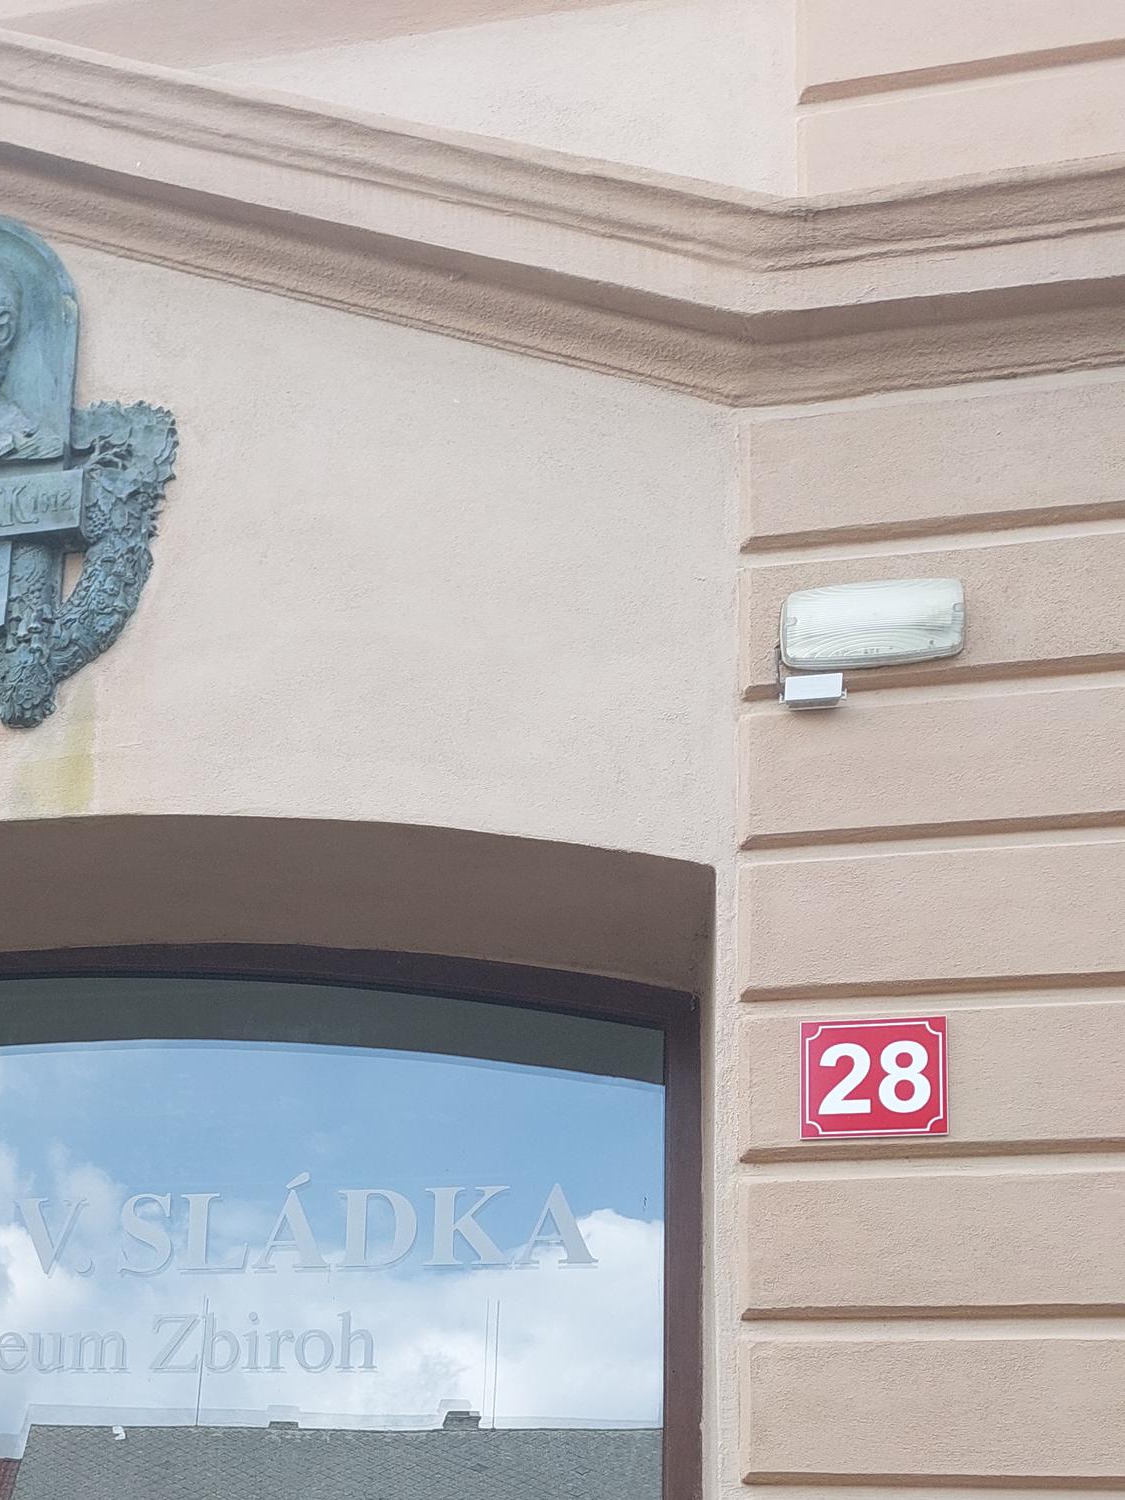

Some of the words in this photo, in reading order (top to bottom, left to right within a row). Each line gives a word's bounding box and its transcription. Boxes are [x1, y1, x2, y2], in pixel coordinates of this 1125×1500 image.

[818, 1040, 932, 1115] 28
[18, 1197, 94, 1279] V.
[116, 1171, 599, 1279] SLÁDKA
[148, 1310, 379, 1375] Zbiroh
